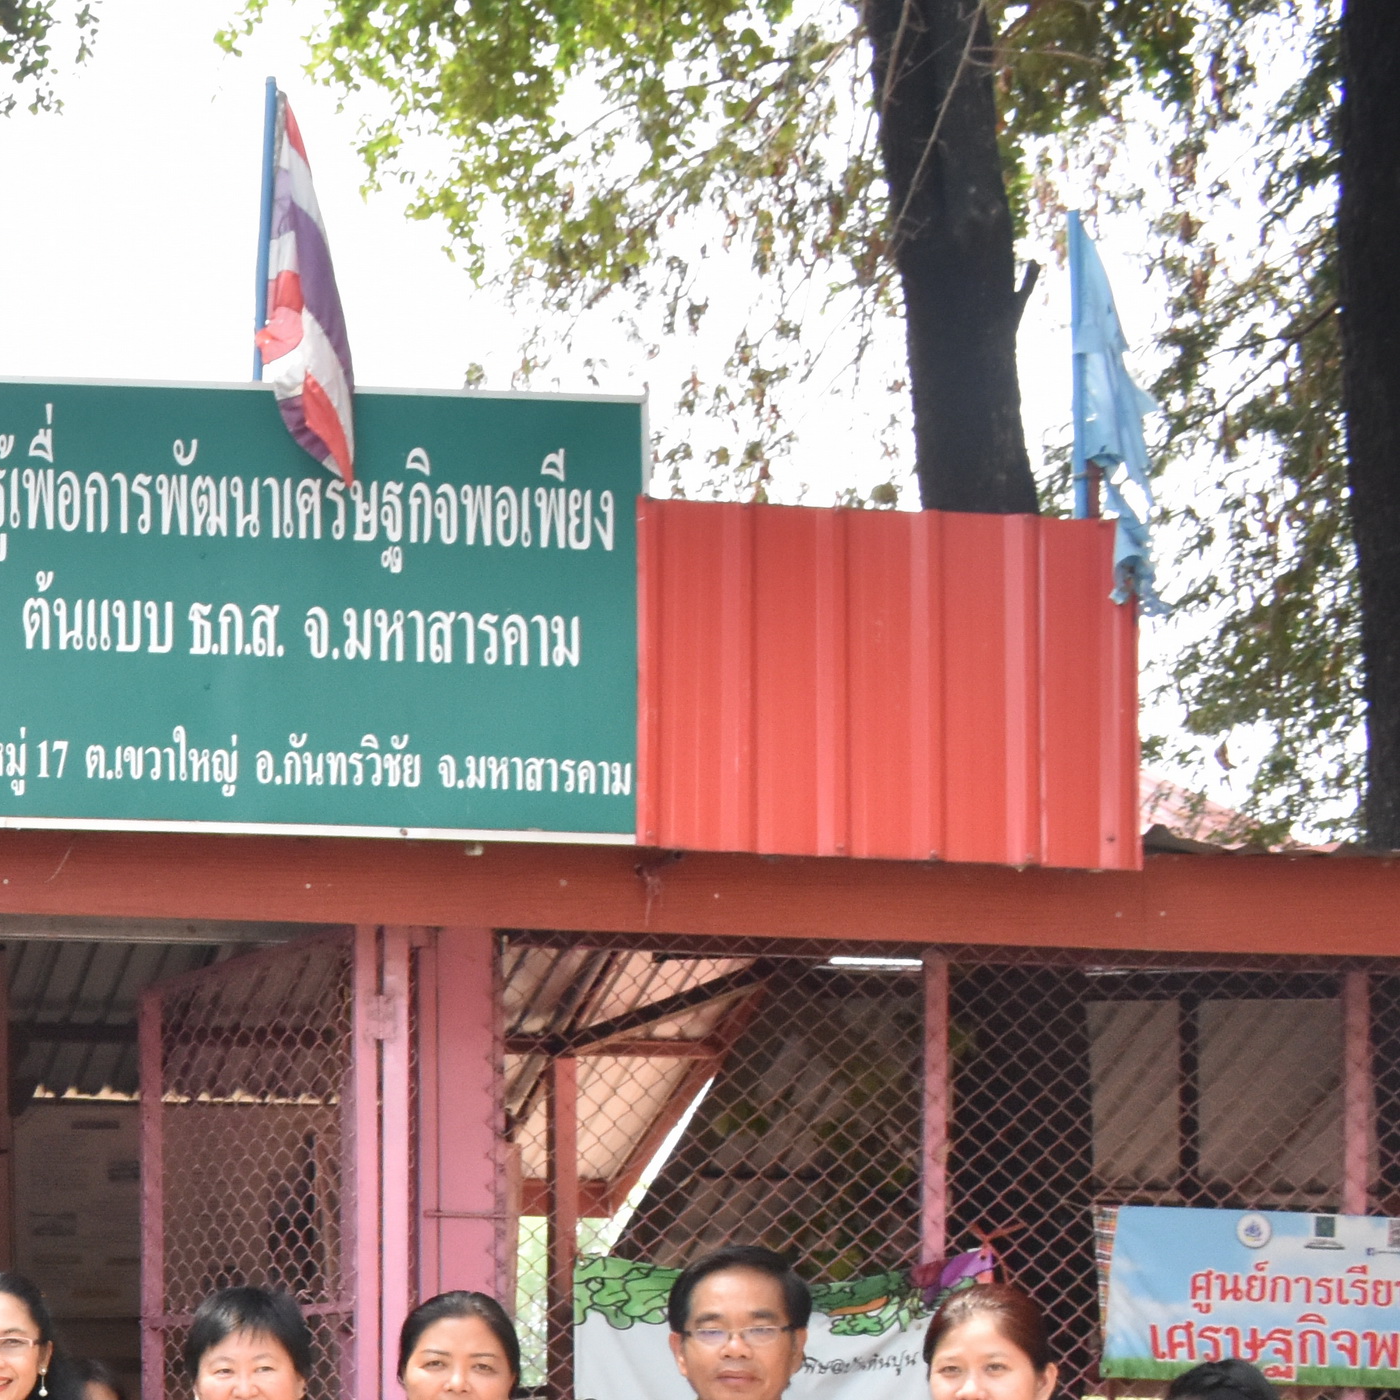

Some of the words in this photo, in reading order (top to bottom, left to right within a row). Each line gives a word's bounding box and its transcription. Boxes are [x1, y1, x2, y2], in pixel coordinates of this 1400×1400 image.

[22, 571, 174, 654] ต้นแบบ
[187, 602, 285, 658] ธ.ก.ส.
[304, 606, 580, 667] จ.มหาสารคาม
[37, 740, 69, 779] 17
[85, 725, 239, 798] ต.เขวาใหญ่
[255, 732, 421, 788] อ.กันทรวิชัย
[438, 754, 632, 796] จ.มหาสารคาม
